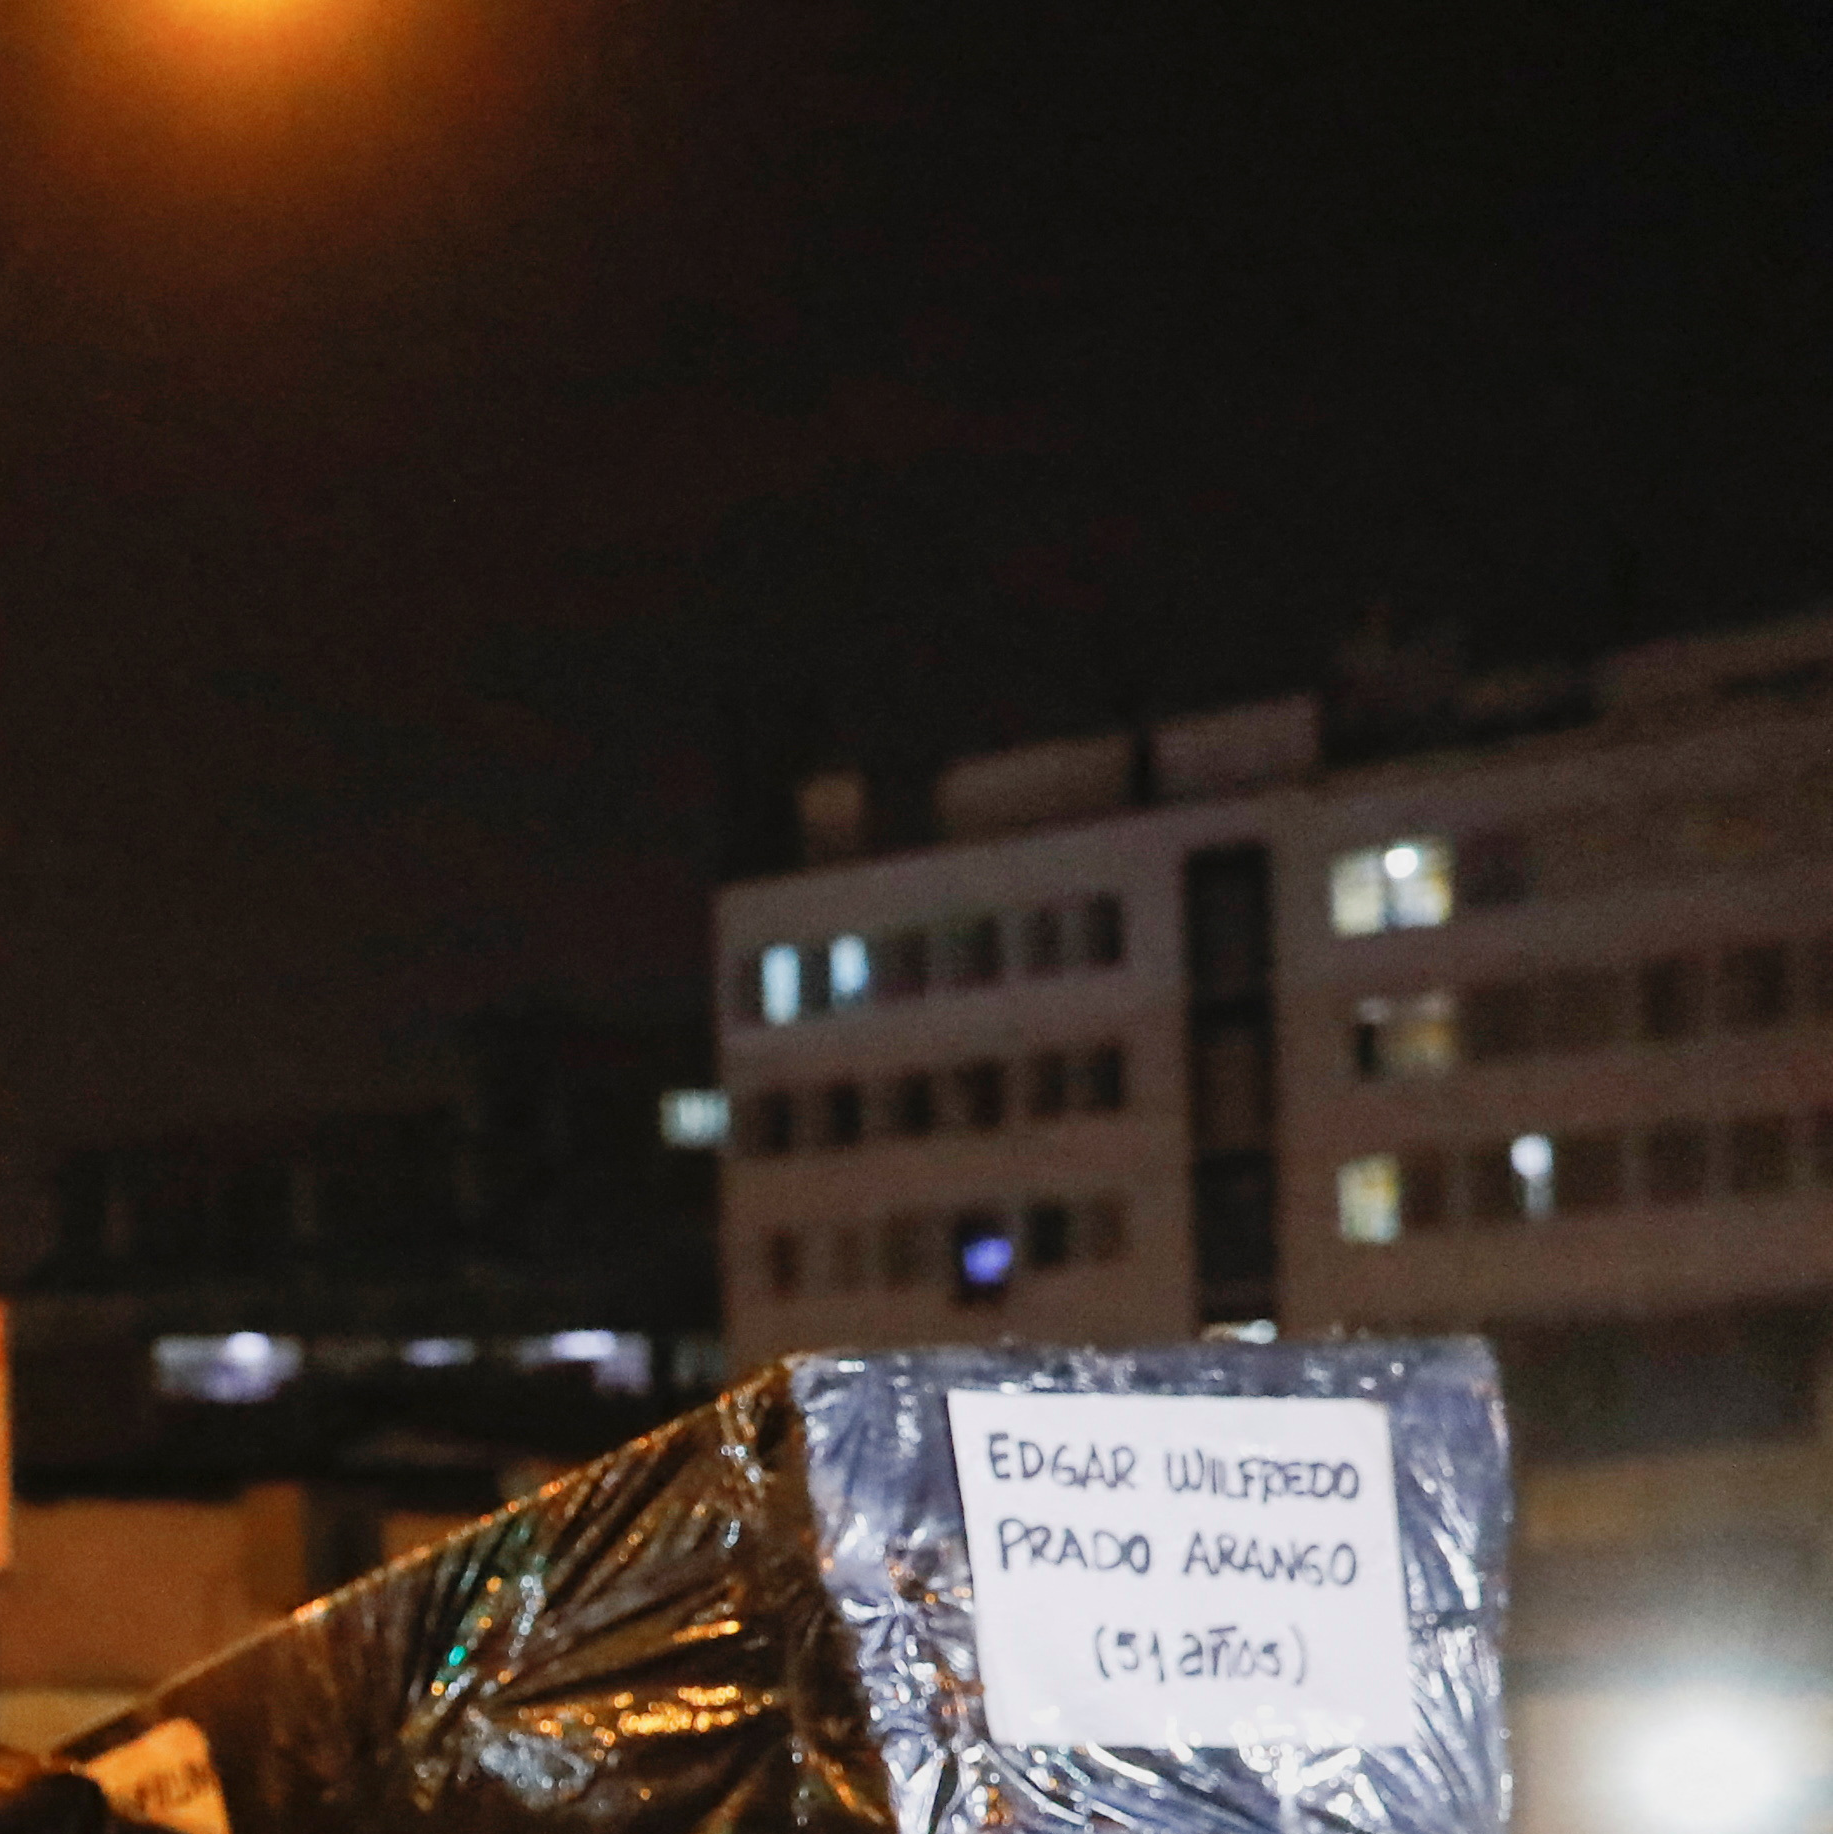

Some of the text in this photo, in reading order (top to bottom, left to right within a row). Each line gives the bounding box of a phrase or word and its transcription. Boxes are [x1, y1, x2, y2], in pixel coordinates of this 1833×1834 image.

[987, 1432, 1360, 1504] EDGAR WILFREDO
[997, 1518, 1357, 1587] PRADO ARANGO
[1093, 1623, 1308, 1687] (51 años)
